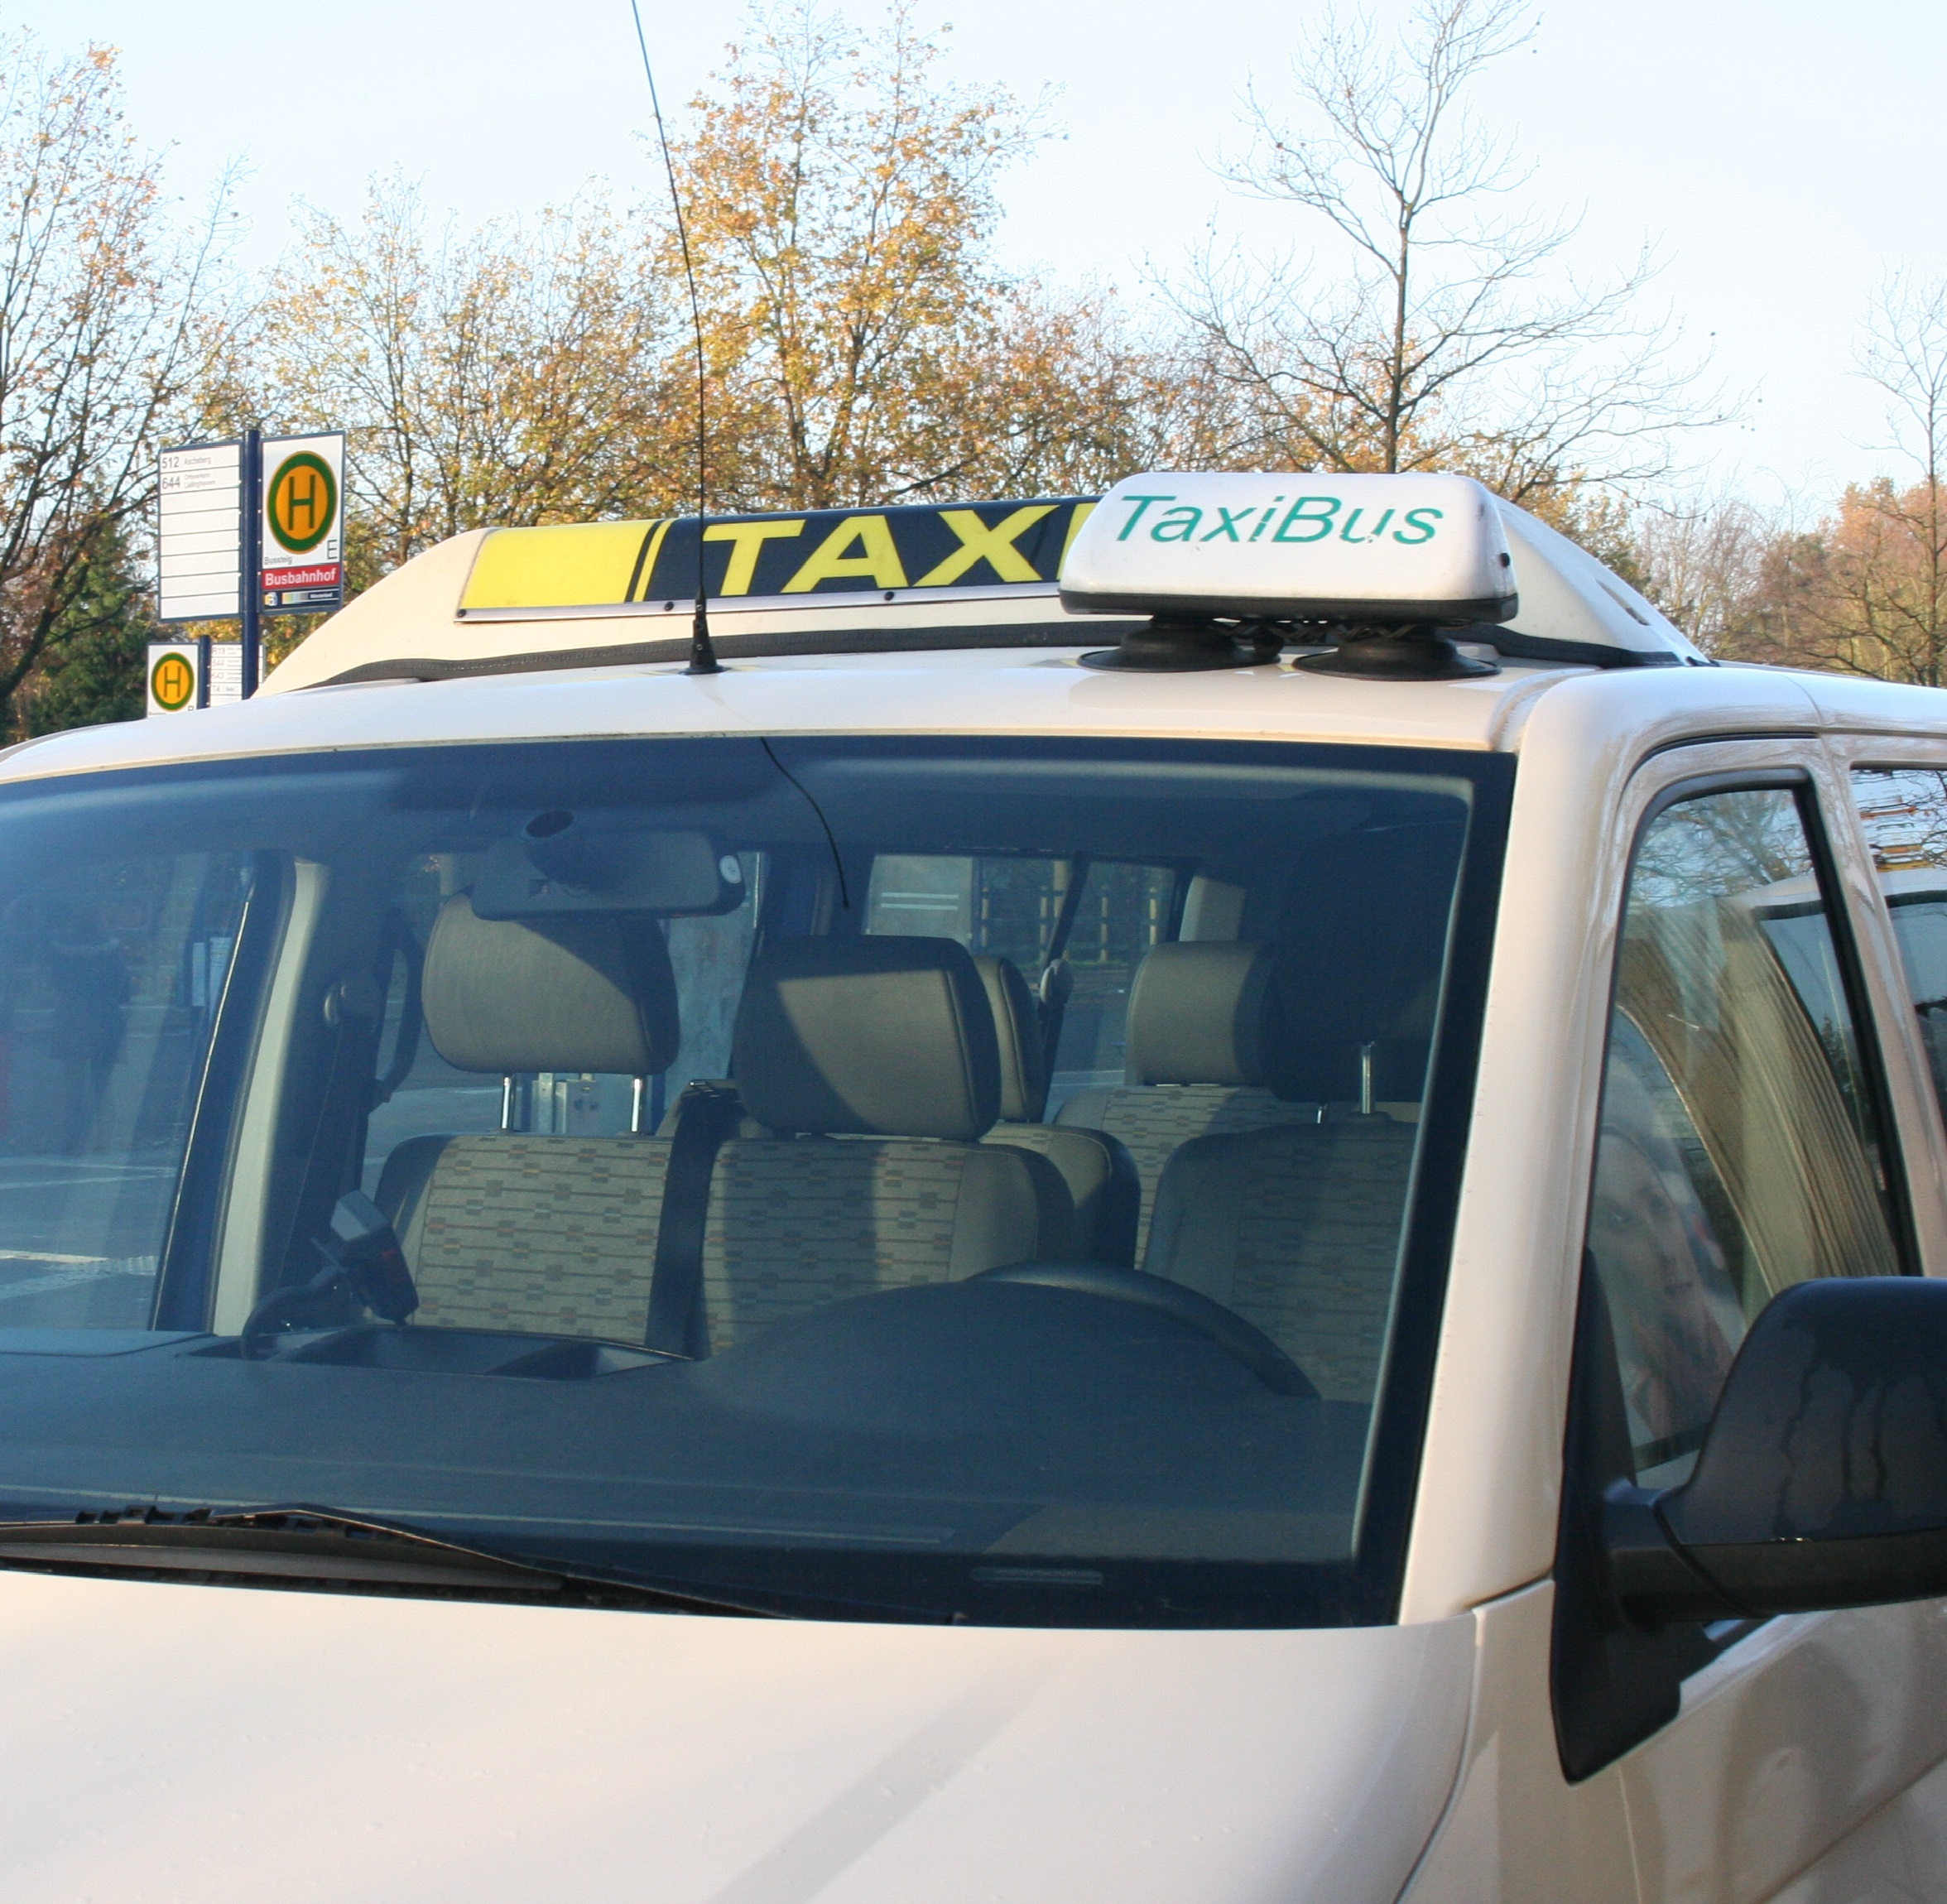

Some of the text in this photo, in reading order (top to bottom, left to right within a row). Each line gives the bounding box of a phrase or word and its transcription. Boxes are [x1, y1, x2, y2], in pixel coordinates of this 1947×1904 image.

[161, 456, 180, 469] 512
[162, 476, 180, 489] 644
[288, 474, 315, 531] H
[1116, 495, 1445, 545] TaxiBus
[327, 539, 338, 560] E
[264, 568, 337, 587] Busbahnhof
[164, 666, 181, 699] H
